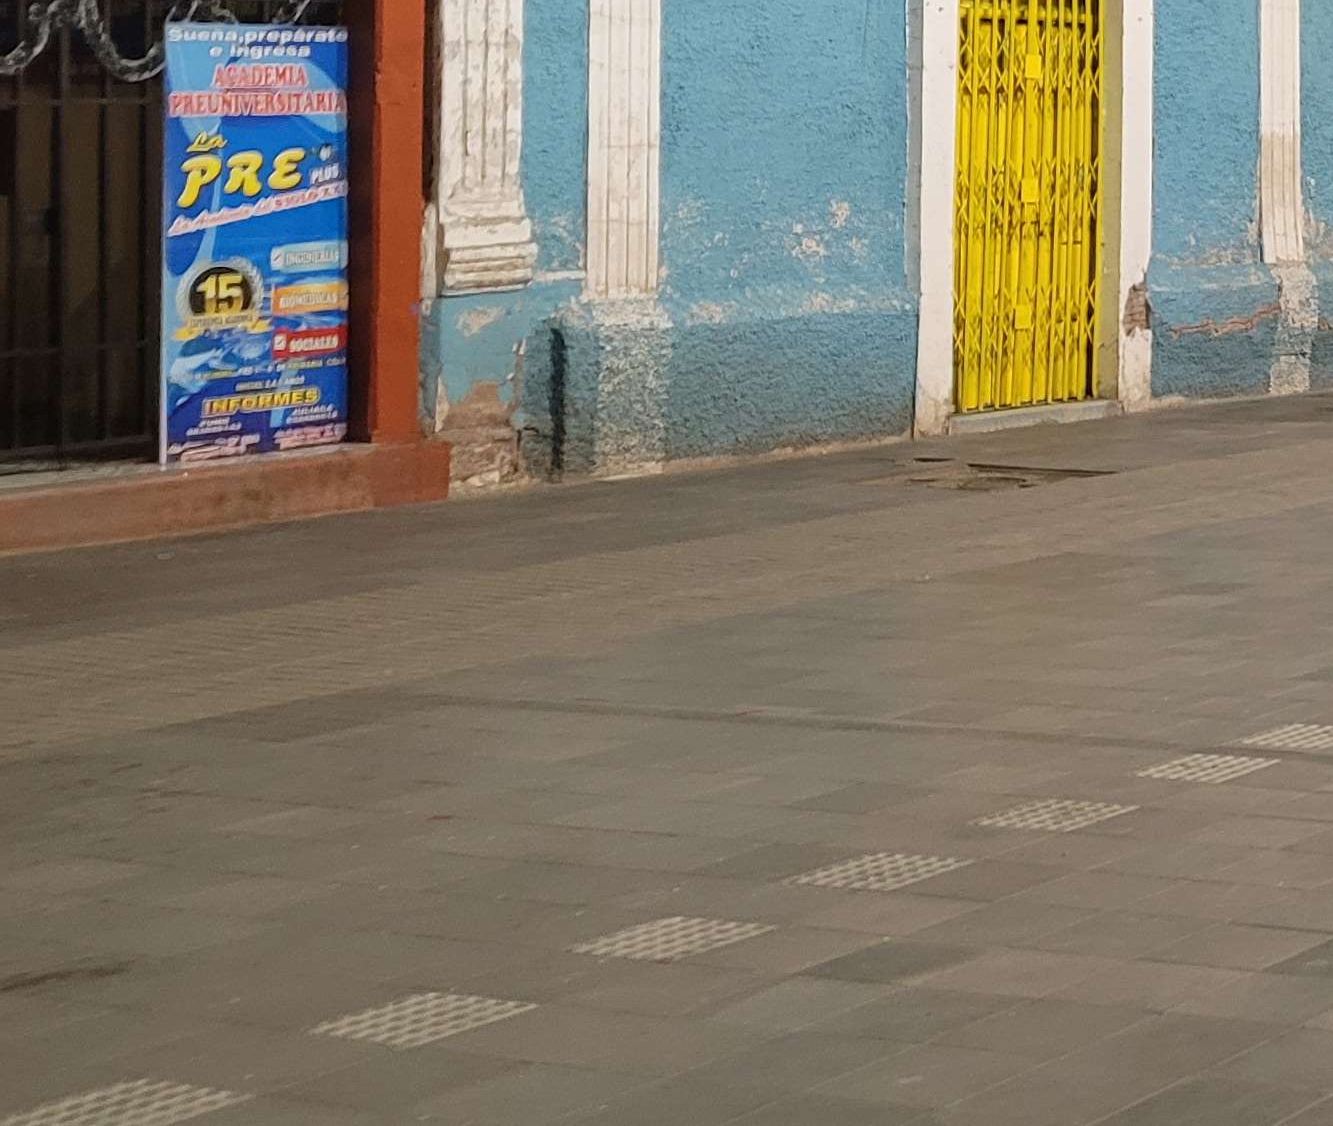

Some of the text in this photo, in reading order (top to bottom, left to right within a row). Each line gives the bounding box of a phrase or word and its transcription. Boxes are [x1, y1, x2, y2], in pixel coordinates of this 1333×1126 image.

[229, 43, 311, 59] ingresa
[213, 64, 308, 87] ACADEMIA
[169, 91, 347, 116] PREUNIVERSITARIA
[186, 131, 227, 154] La
[176, 147, 306, 209] PRE
[310, 163, 340, 185] PLUS
[196, 273, 244, 315] 15
[202, 388, 320, 417] INFORMES
